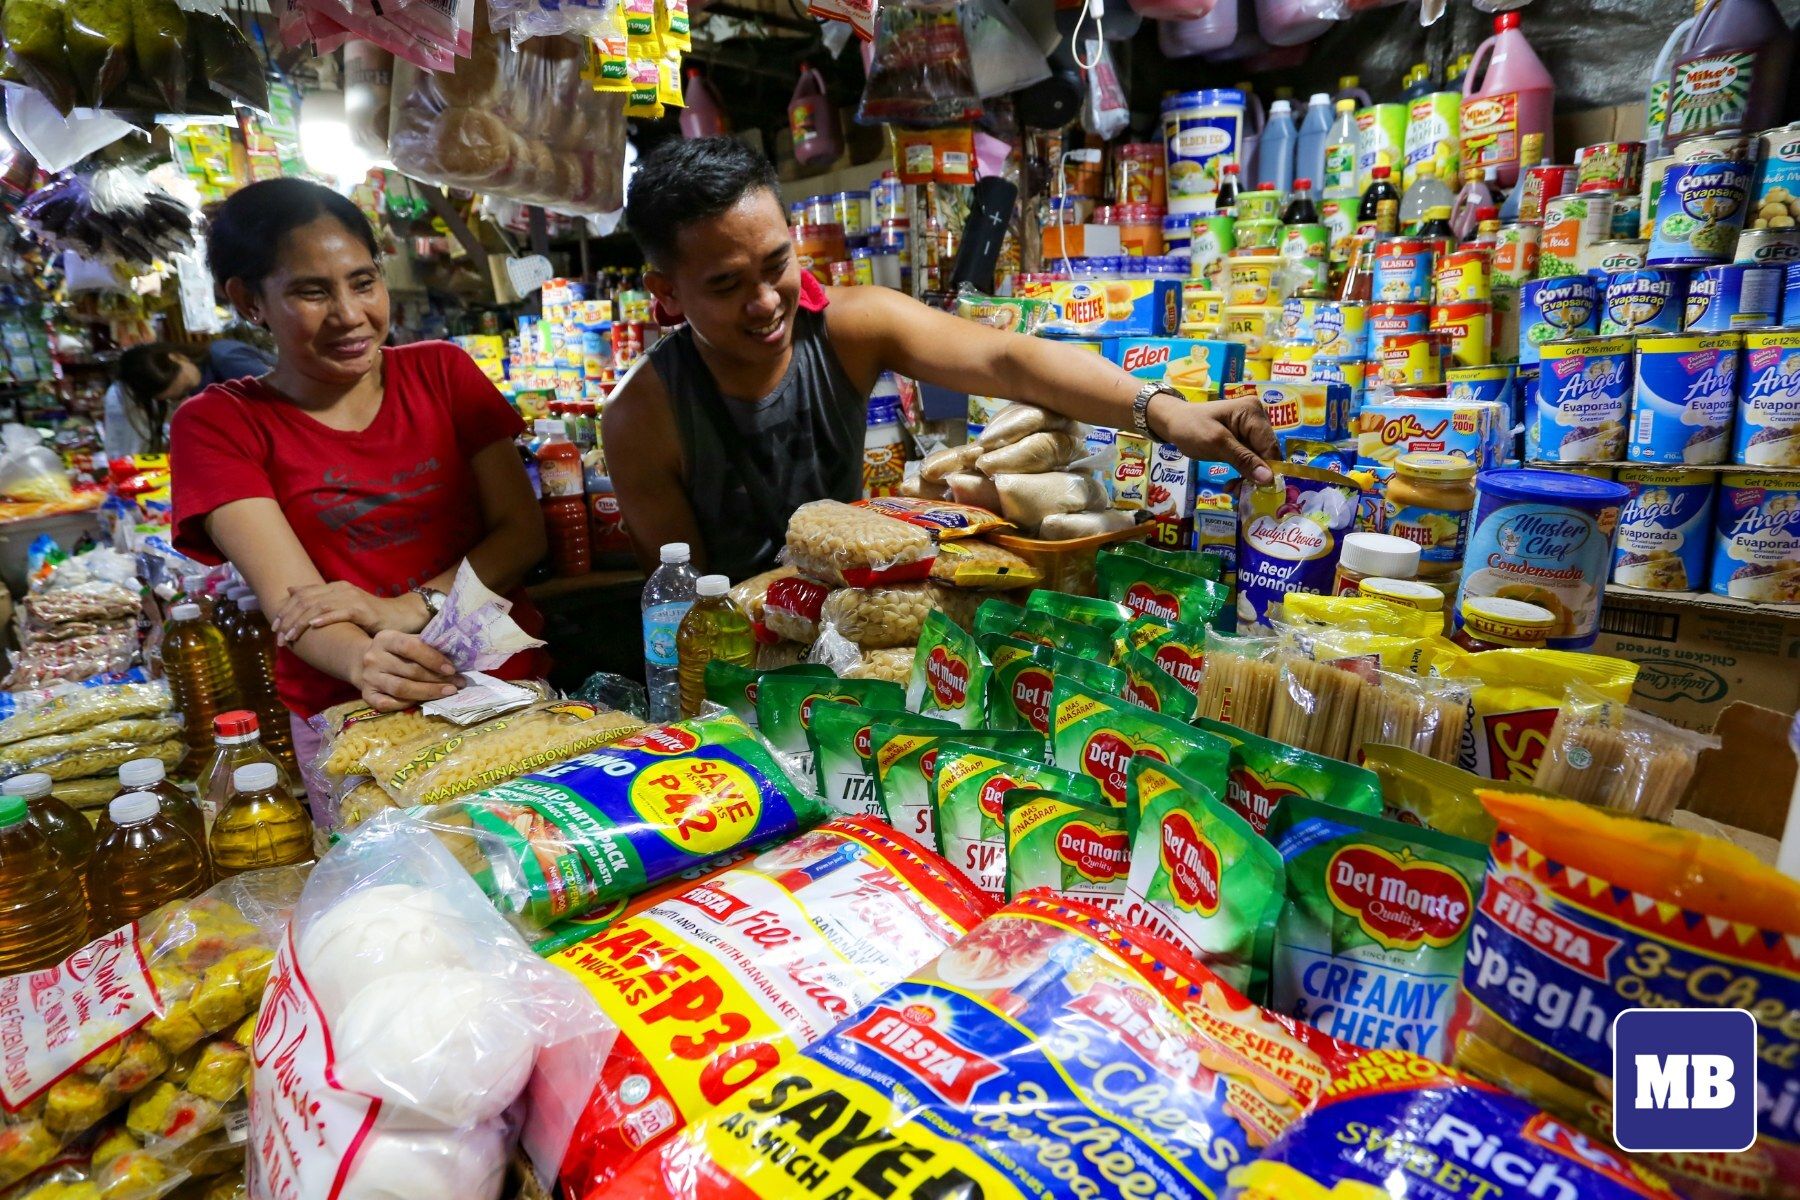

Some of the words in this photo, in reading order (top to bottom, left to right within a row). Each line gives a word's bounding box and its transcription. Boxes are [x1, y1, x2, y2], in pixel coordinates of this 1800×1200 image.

[1686, 66, 1738, 84] Mike's
[1677, 174, 1722, 191] Cow
[1380, 261, 1415, 270] ALASKA
[1602, 258, 1639, 268] UFC
[1755, 247, 1799, 259] UFC
[1438, 269, 1462, 280] ALASKA
[1690, 279, 1717, 295] Bell
[1535, 288, 1571, 304] Cow
[1607, 282, 1637, 298] Cow
[1638, 279, 1673, 295] Bell
[1609, 294, 1664, 307] Evapsarap
[1065, 297, 1106, 324] CHEEZEE
[1374, 321, 1407, 329] ALASKA
[1384, 351, 1409, 359] ALASKA
[1565, 347, 1582, 355] Get
[1582, 346, 1599, 354] 12%
[1699, 340, 1716, 349] Get
[1762, 337, 1780, 346] Get
[1123, 345, 1170, 373] Eden
[1273, 364, 1305, 375] ALASKA
[1557, 361, 1625, 403] Angel
[1684, 367, 1733, 400] Ang
[1749, 366, 1800, 397] Ang
[1563, 401, 1622, 413] Evaporada
[1754, 400, 1800, 412] Evapor
[1453, 421, 1474, 432] 200g
[1116, 463, 1143, 480] Cream
[1151, 463, 1186, 486] Cream
[1209, 465, 1229, 475] Eden
[1638, 474, 1655, 483] 12%
[1744, 479, 1761, 487] Get
[1763, 479, 1783, 487] 12%
[1621, 492, 1685, 527] Angel
[1730, 506, 1800, 536] Ange
[1156, 522, 1178, 545] 15
[1251, 520, 1286, 546] Lady's
[1286, 526, 1323, 550] Choice
[1514, 514, 1587, 537] Master
[1620, 527, 1678, 541] Evaporada
[1525, 537, 1571, 562] Chef
[1259, 561, 1294, 579] Real
[1487, 552, 1584, 581] Condensada
[1238, 568, 1321, 595] Mayonnaise
[1128, 592, 1145, 610] Del
[1145, 598, 1177, 621] Monte
[928, 659, 941, 679] Del
[940, 664, 967, 694] Monte
[1671, 674, 1716, 697] Lady's
[1016, 682, 1037, 705] Del
[1065, 700, 1080, 713] MAS
[1088, 742, 1114, 769] Del
[424, 778, 478, 803] MAMA
[479, 763, 520, 783] TINA
[521, 745, 569, 771] ELBOW
[941, 760, 984, 791] PINASARAP!
[684, 770, 696, 782] AS
[715, 806, 728, 820] AS
[690, 761, 754, 823] SAVE
[1229, 780, 1252, 805] Del
[1013, 804, 1057, 836] PINASARAP!
[1020, 805, 1037, 819] MAS
[560, 800, 604, 834] PARTY
[594, 832, 630, 873] PACK
[1061, 832, 1085, 854] Del
[595, 858, 613, 885] PASTA
[1081, 855, 1112, 872] Quality
[1163, 823, 1183, 859] Del
[1183, 843, 1217, 899] Monte
[1176, 863, 1200, 898] Quality
[1337, 861, 1375, 897] Del
[1379, 875, 1466, 925] Monte
[686, 888, 733, 915] FIESTA
[1368, 900, 1423, 933] Quality
[1492, 891, 1592, 967] FIESTA
[581, 922, 701, 996] SAVE
[676, 915, 695, 933] AND
[692, 926, 719, 946] SAUCE
[716, 940, 742, 963] WITH
[738, 956, 783, 1005] BANANA
[1362, 949, 1387, 960] SINCE
[575, 953, 625, 981] MUCH
[613, 975, 648, 1007] AS
[1302, 960, 1450, 1020] CREAMY
[1466, 923, 1613, 1046] Spagh
[638, 974, 780, 1107] P30
[1090, 998, 1200, 1080] FIESTA
[1187, 1005, 1295, 1065] CHEESIER
[1294, 1058, 1327, 1076] AND
[1308, 1004, 1440, 1056] CHEESY
[866, 1017, 968, 1086] FIESTA
[1349, 1049, 1418, 1076] NEW
[853, 1063, 872, 1079] AND
[870, 1070, 896, 1088] SAUCE
[640, 1109, 661, 1133] 420
[748, 1074, 937, 1193] SAVE
[719, 1112, 757, 1139] AS
[752, 1120, 831, 1192] MUCH
[1425, 1112, 1579, 1200] Rich
